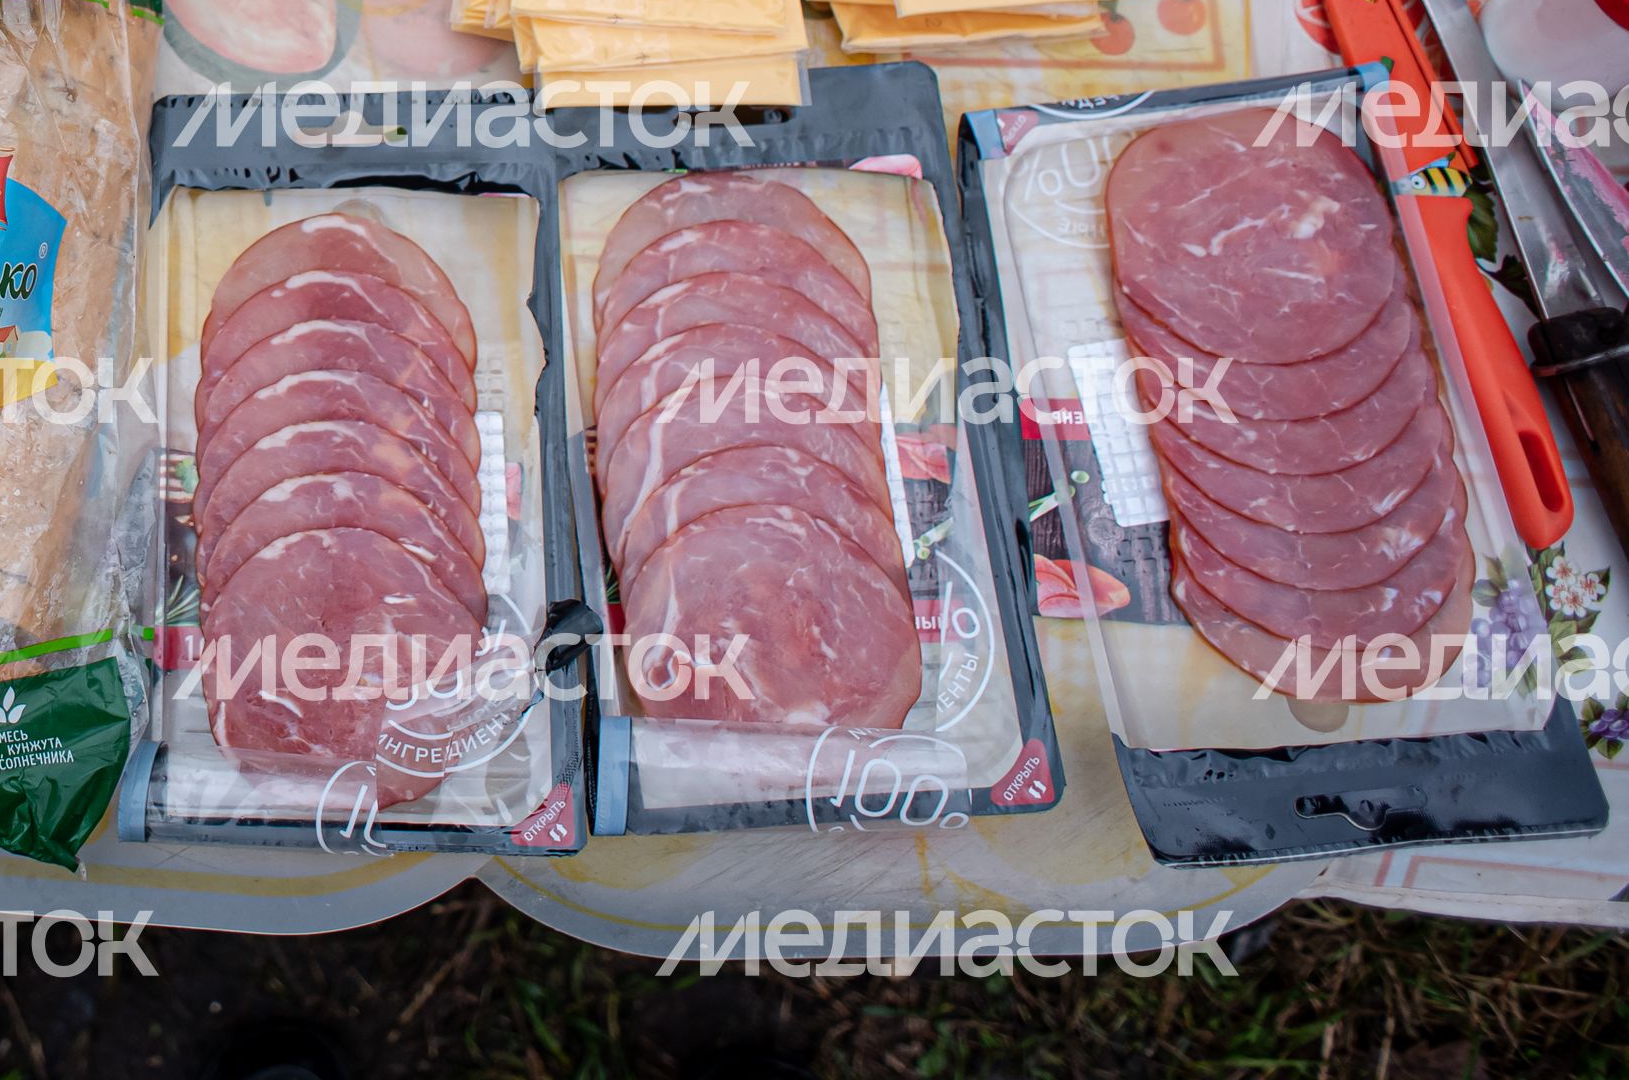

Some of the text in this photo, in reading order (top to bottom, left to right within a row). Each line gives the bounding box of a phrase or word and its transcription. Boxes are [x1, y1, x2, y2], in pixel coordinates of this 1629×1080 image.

[7, 736, 63, 756] КУНЖУТА
[1002, 755, 1041, 802] ОТКРЫТЬ
[523, 799, 567, 842] ОТКРЫТЬ
